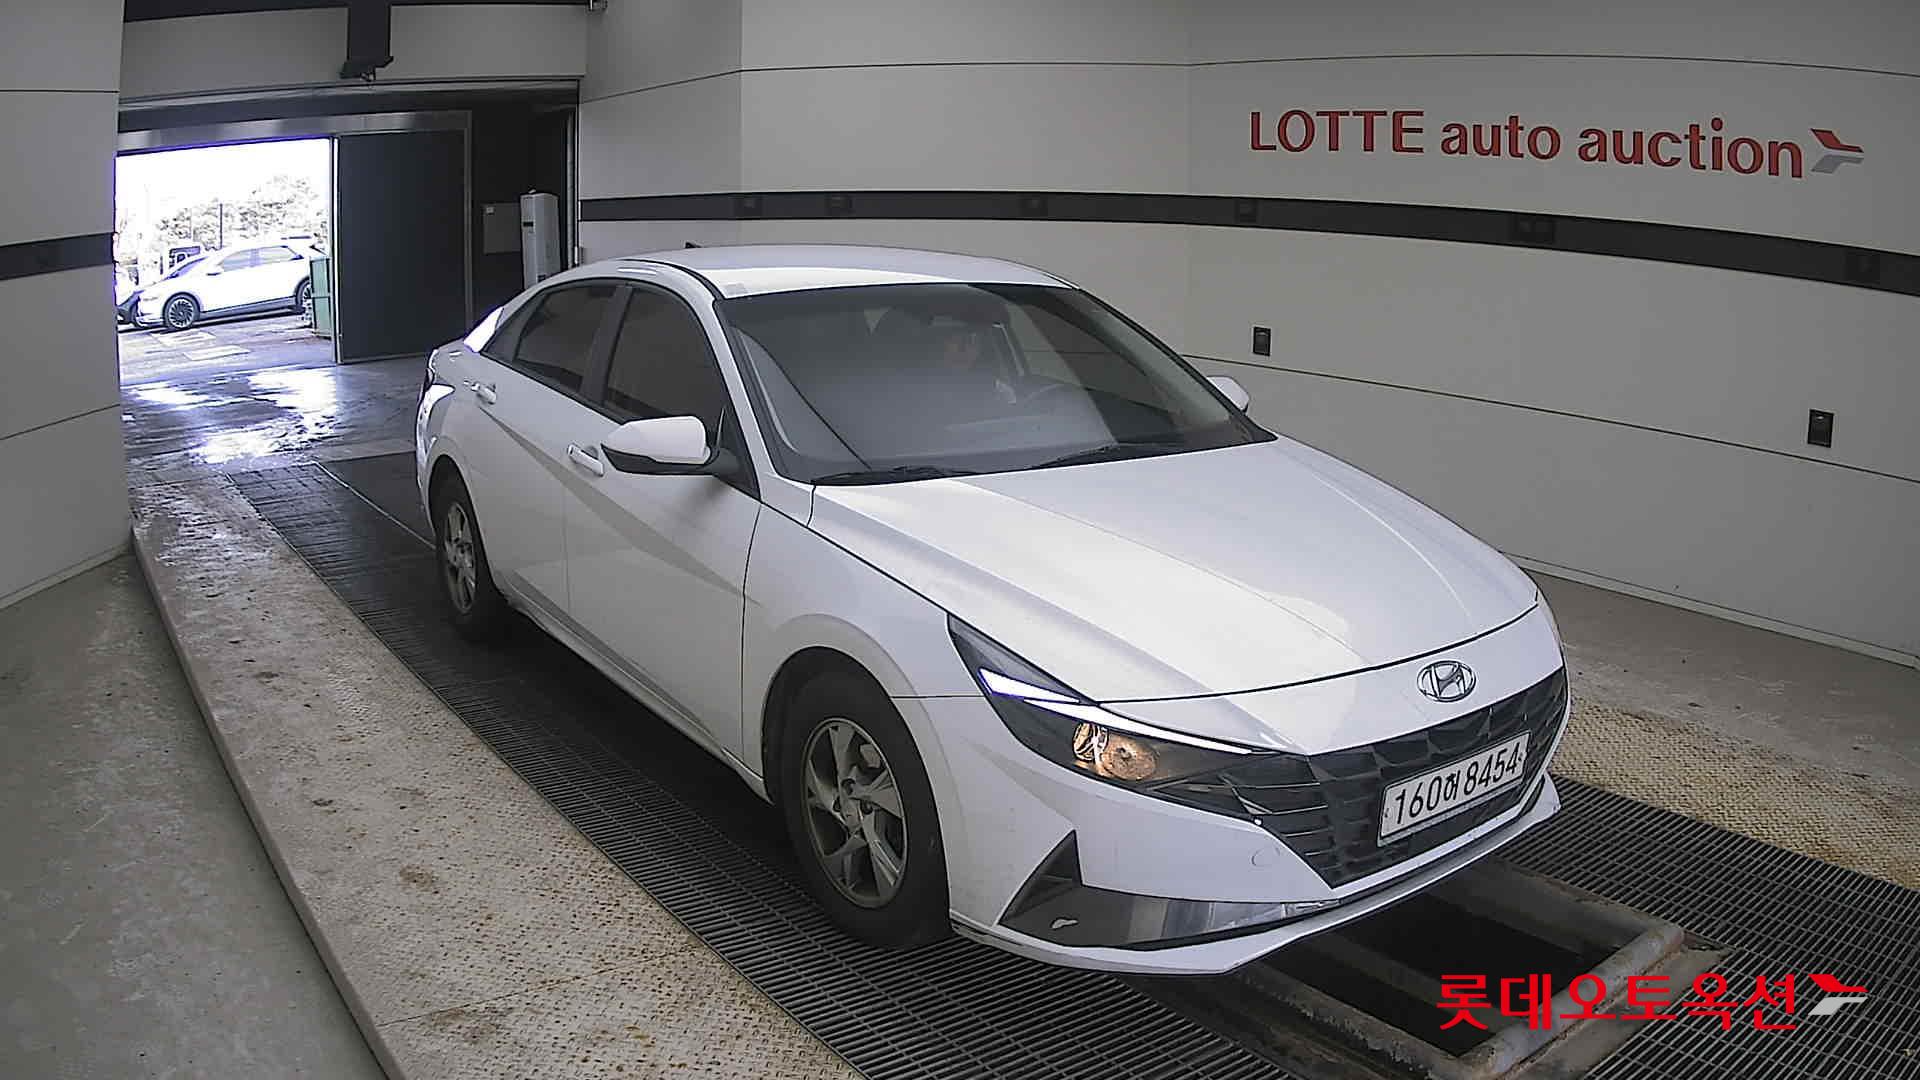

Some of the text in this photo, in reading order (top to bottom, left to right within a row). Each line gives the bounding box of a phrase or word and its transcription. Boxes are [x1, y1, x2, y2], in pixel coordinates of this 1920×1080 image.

[1250, 109, 1804, 178] LOTTE auto auction
[1463, 741, 1521, 796] 8454
